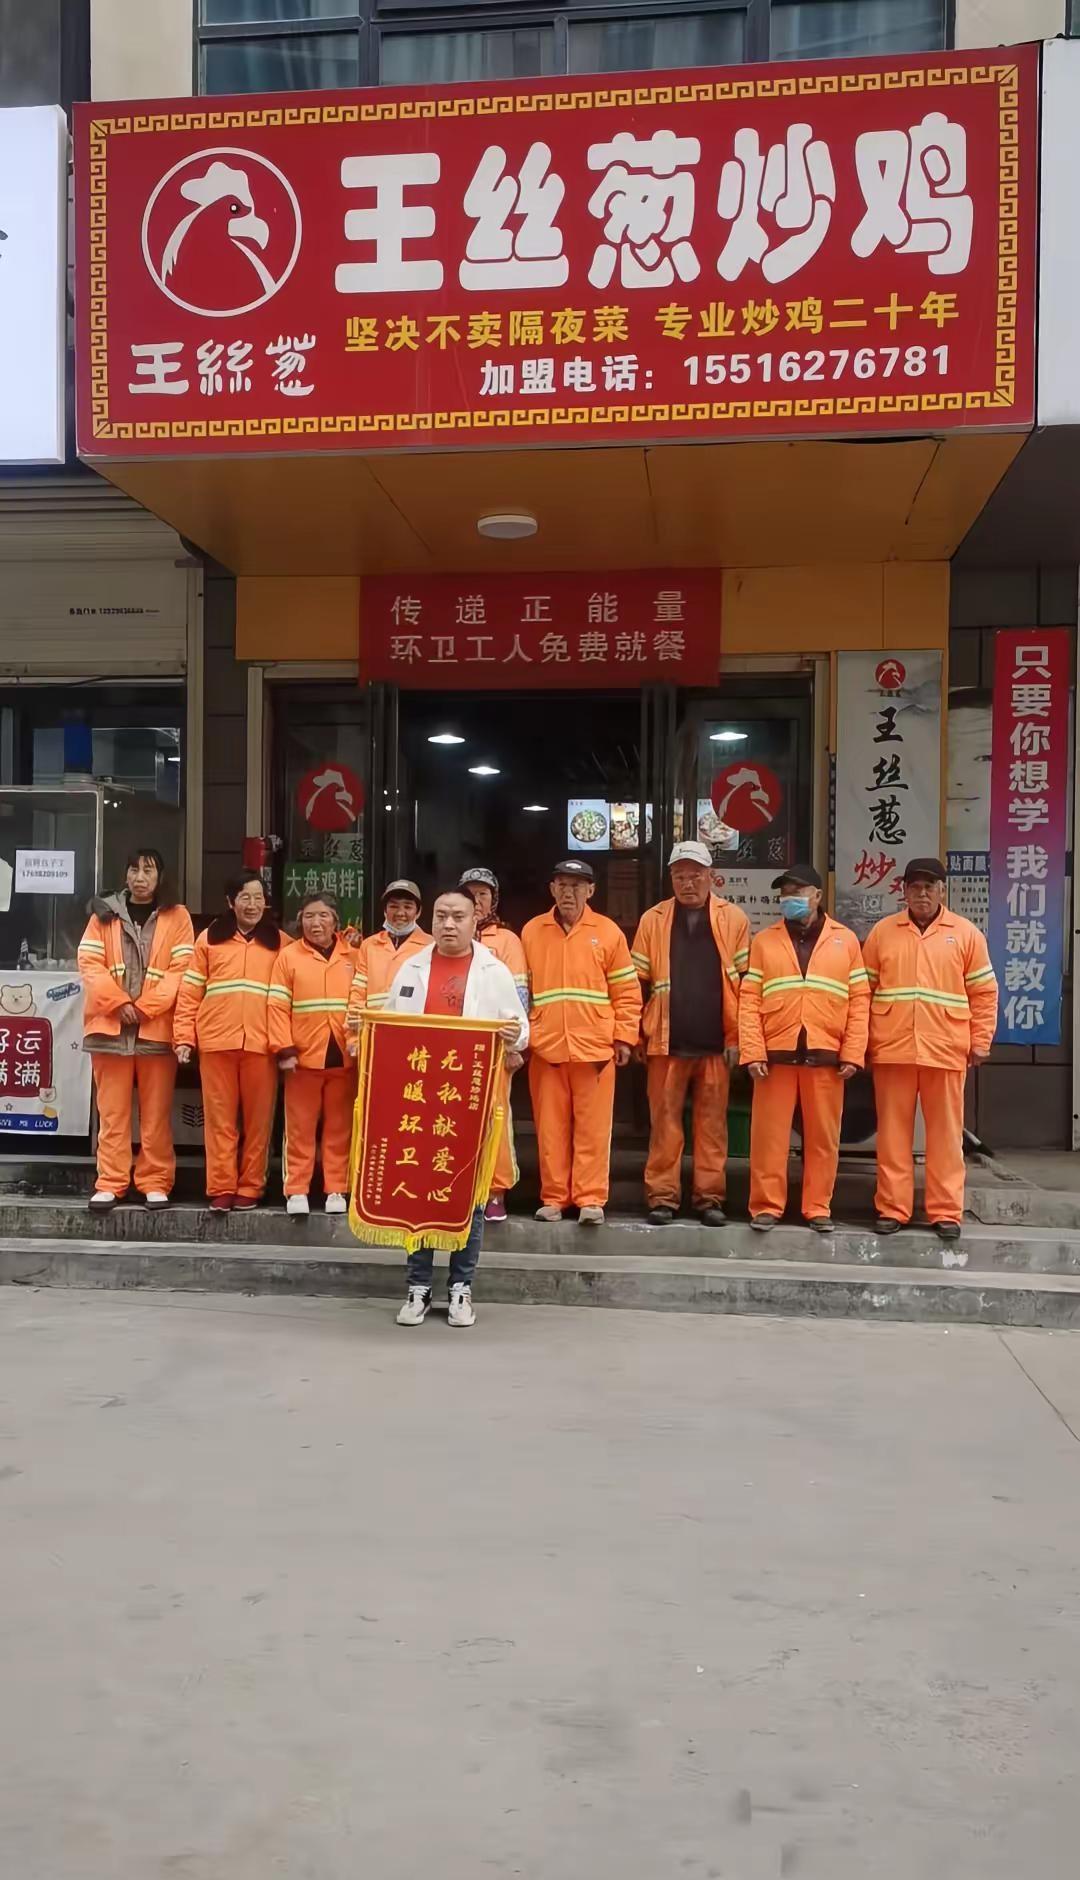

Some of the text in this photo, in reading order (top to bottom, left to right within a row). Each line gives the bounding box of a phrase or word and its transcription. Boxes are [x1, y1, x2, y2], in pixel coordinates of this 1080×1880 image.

[334, 111, 974, 294] 王丝葱炒鸡
[344, 291, 960, 353] 坚决不卖隔夜菜 专业炒鸡二十年
[683, 344, 950, 386] 15516276781
[390, 590, 687, 626] 传递正能量
[390, 629, 686, 665] 环卫工人免费就餐
[1003, 645, 1052, 1031] 只要你想学 我们就教你
[391, 1046, 432, 1200] 情暖环卫人
[427, 1049, 464, 1203] 无私献爱心
